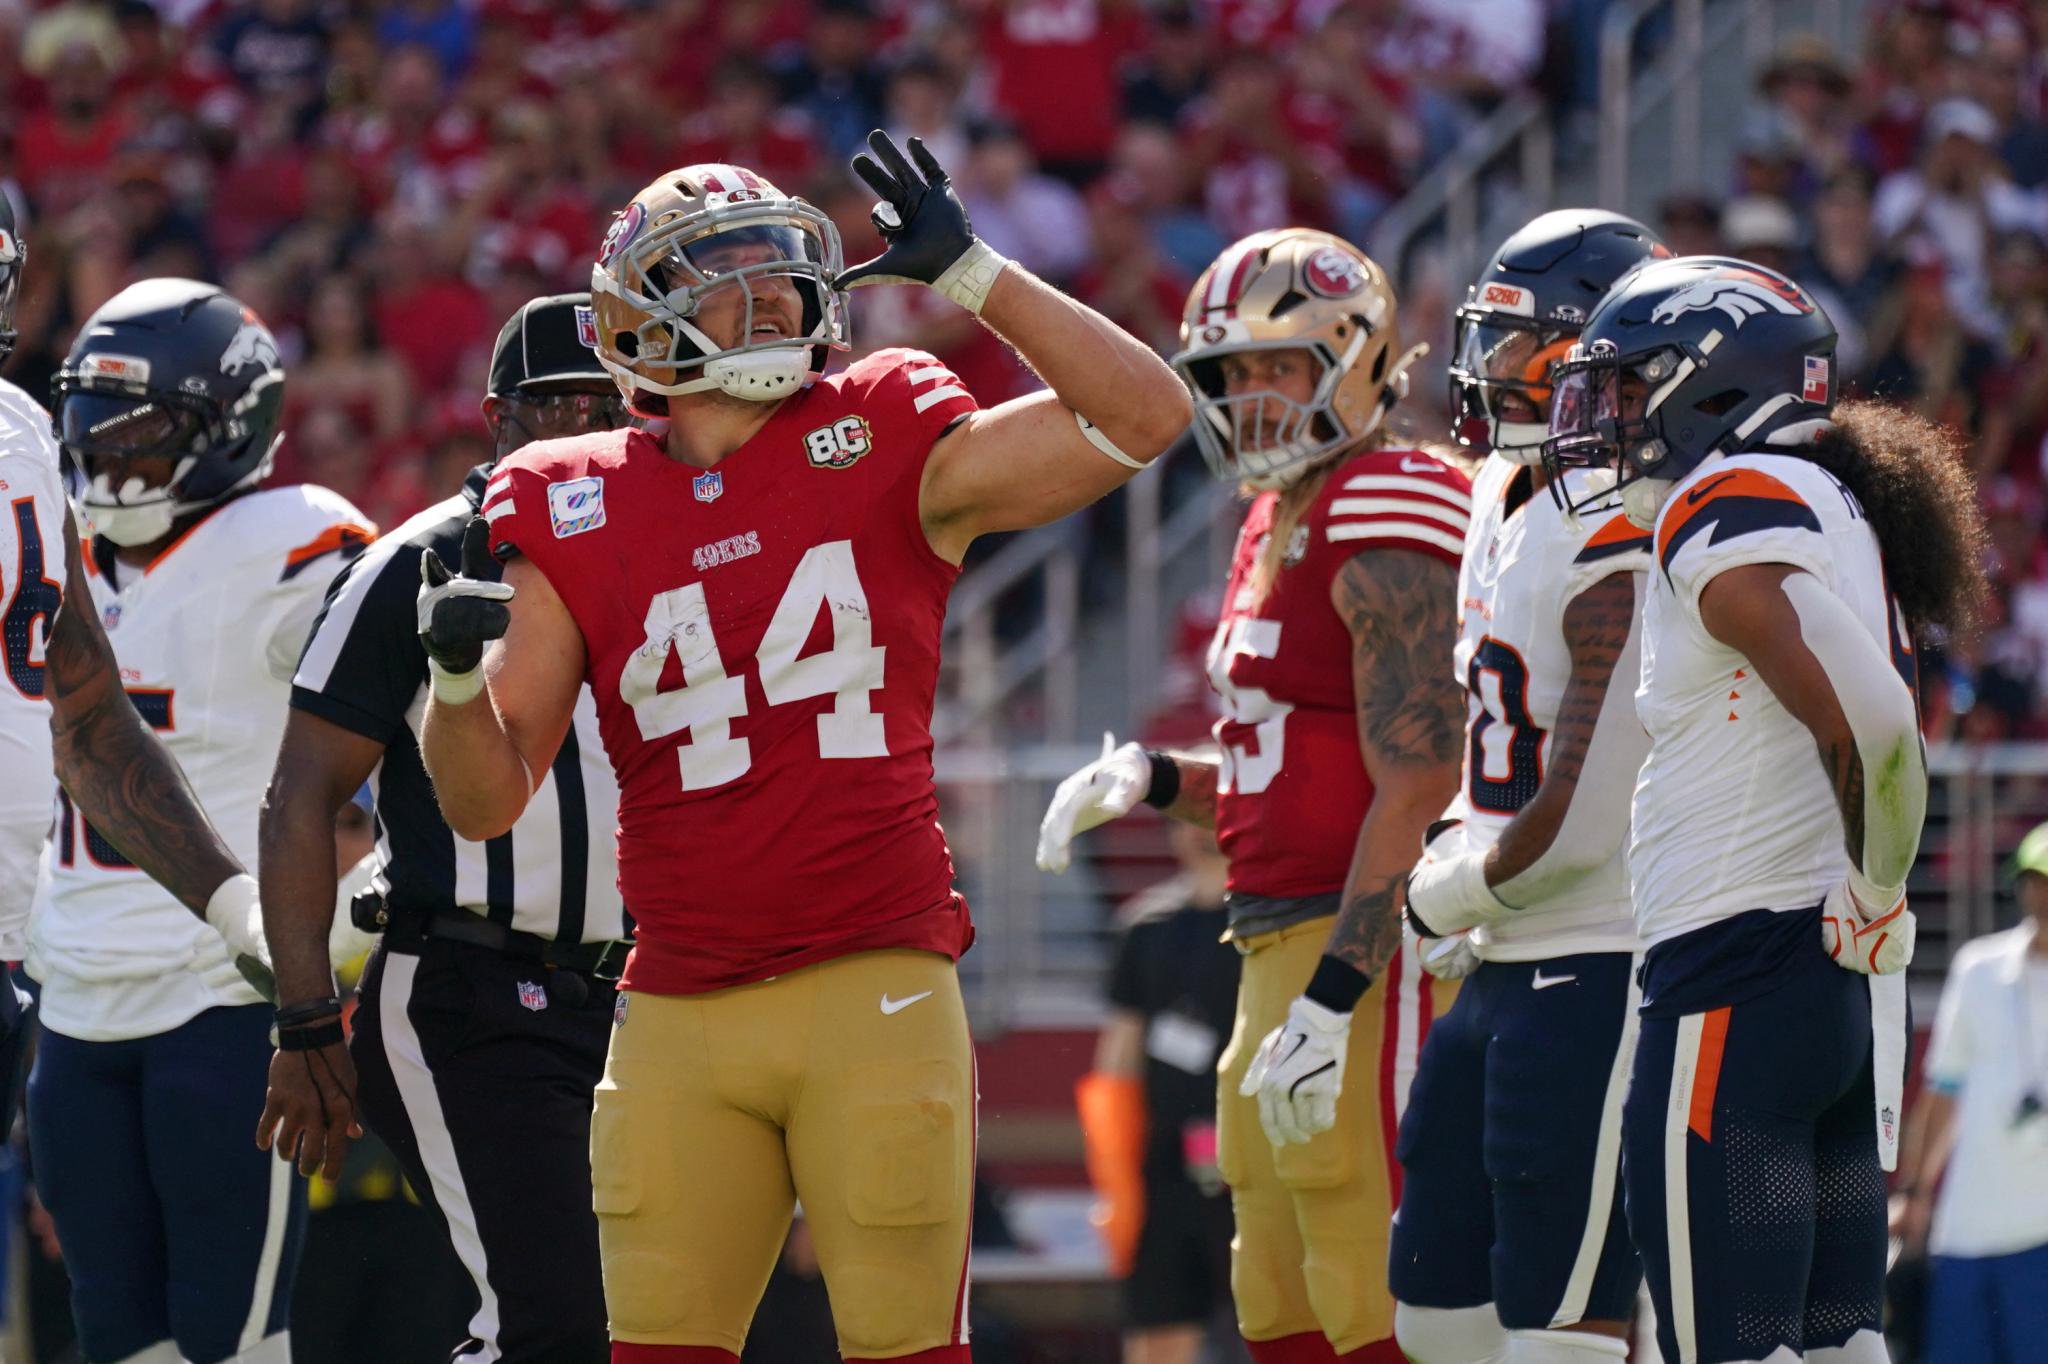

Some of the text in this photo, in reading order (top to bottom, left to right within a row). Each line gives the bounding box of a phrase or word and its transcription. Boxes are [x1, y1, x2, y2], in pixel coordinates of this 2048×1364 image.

[1485, 286, 1522, 306] 5280
[0, 495, 64, 701] 6
[692, 530, 762, 572] 49ERS
[619, 539, 890, 792] 44
